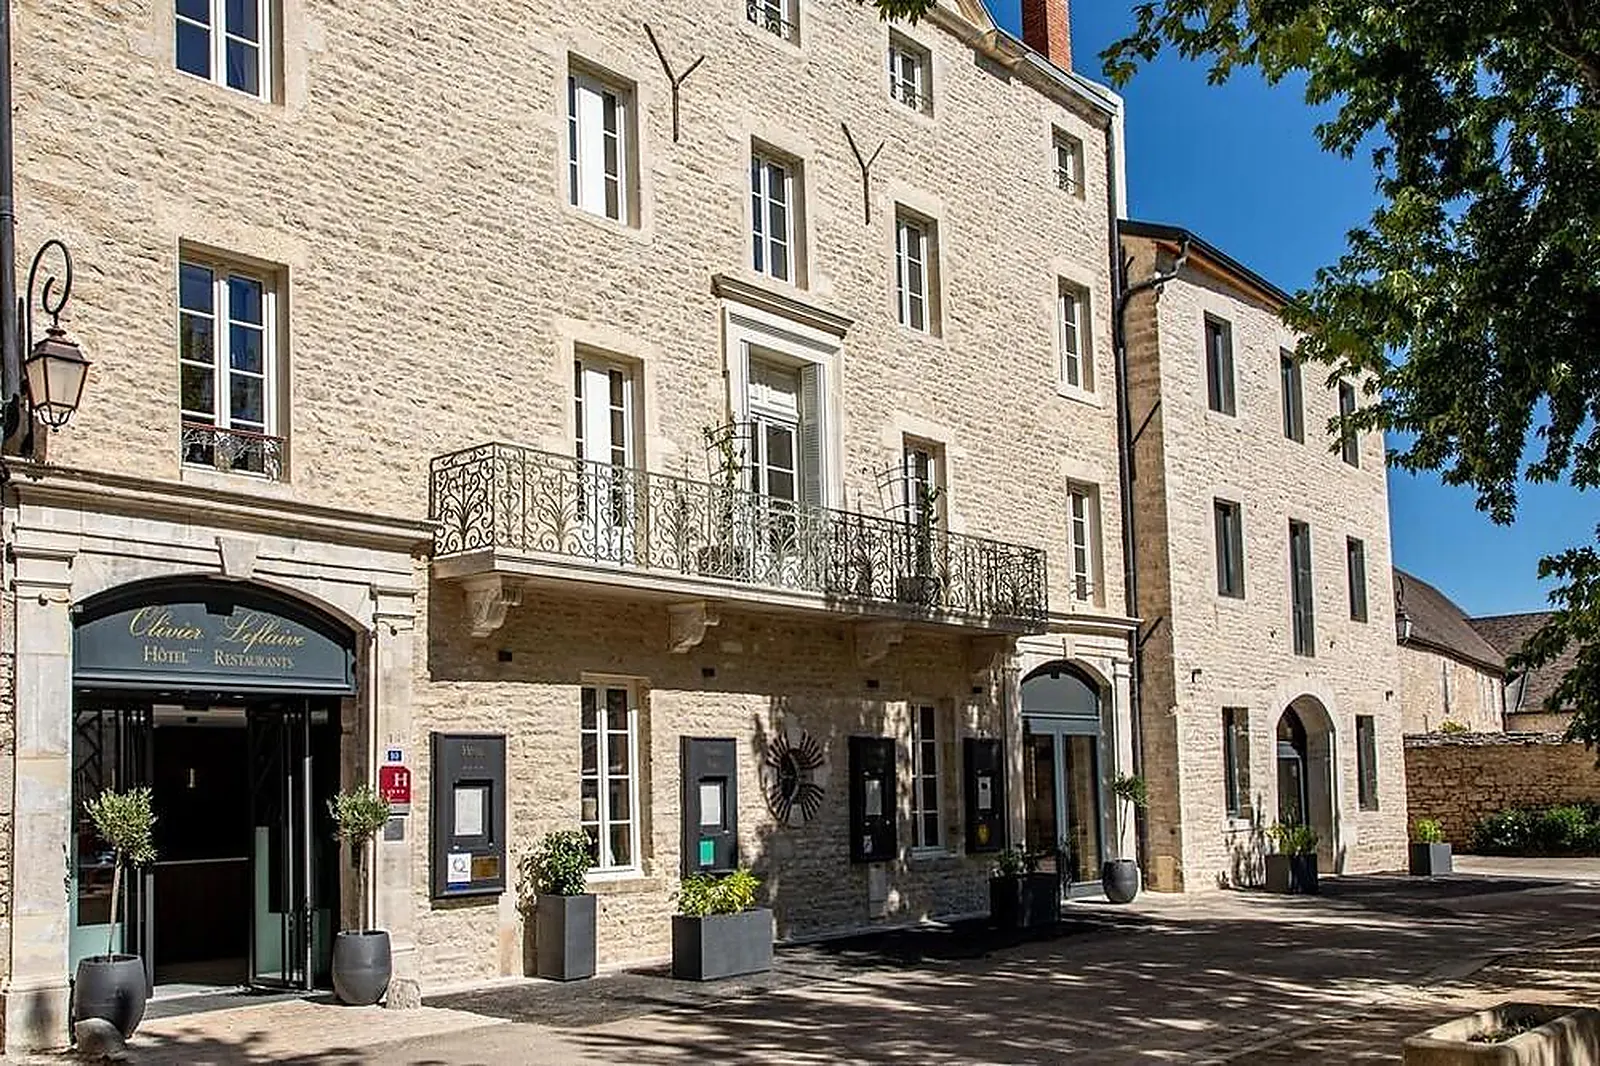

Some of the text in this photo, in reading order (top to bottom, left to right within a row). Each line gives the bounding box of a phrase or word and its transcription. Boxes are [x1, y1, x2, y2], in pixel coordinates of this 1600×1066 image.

[130, 606, 306, 654] Olivier Leflaive
[394, 772, 408, 788] H
